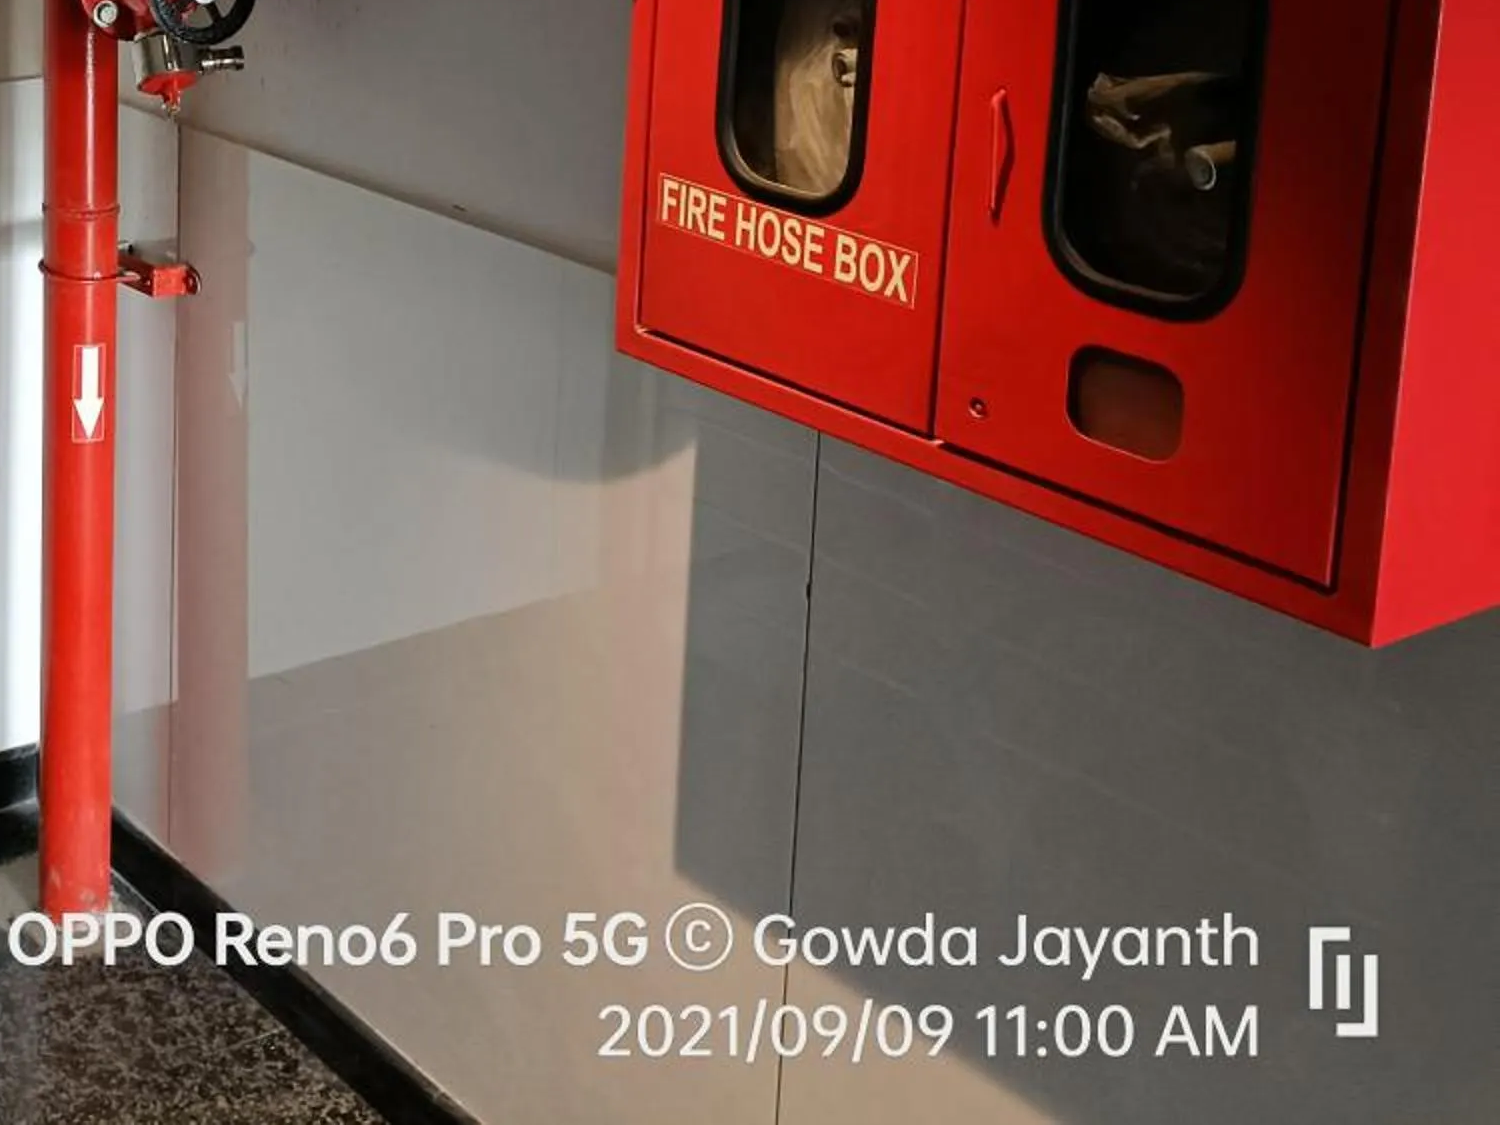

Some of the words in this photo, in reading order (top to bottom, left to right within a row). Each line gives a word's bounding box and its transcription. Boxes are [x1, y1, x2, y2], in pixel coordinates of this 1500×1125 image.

[661, 178, 727, 241] FIRE
[735, 202, 825, 275] HOSE
[833, 233, 911, 303] BOX
